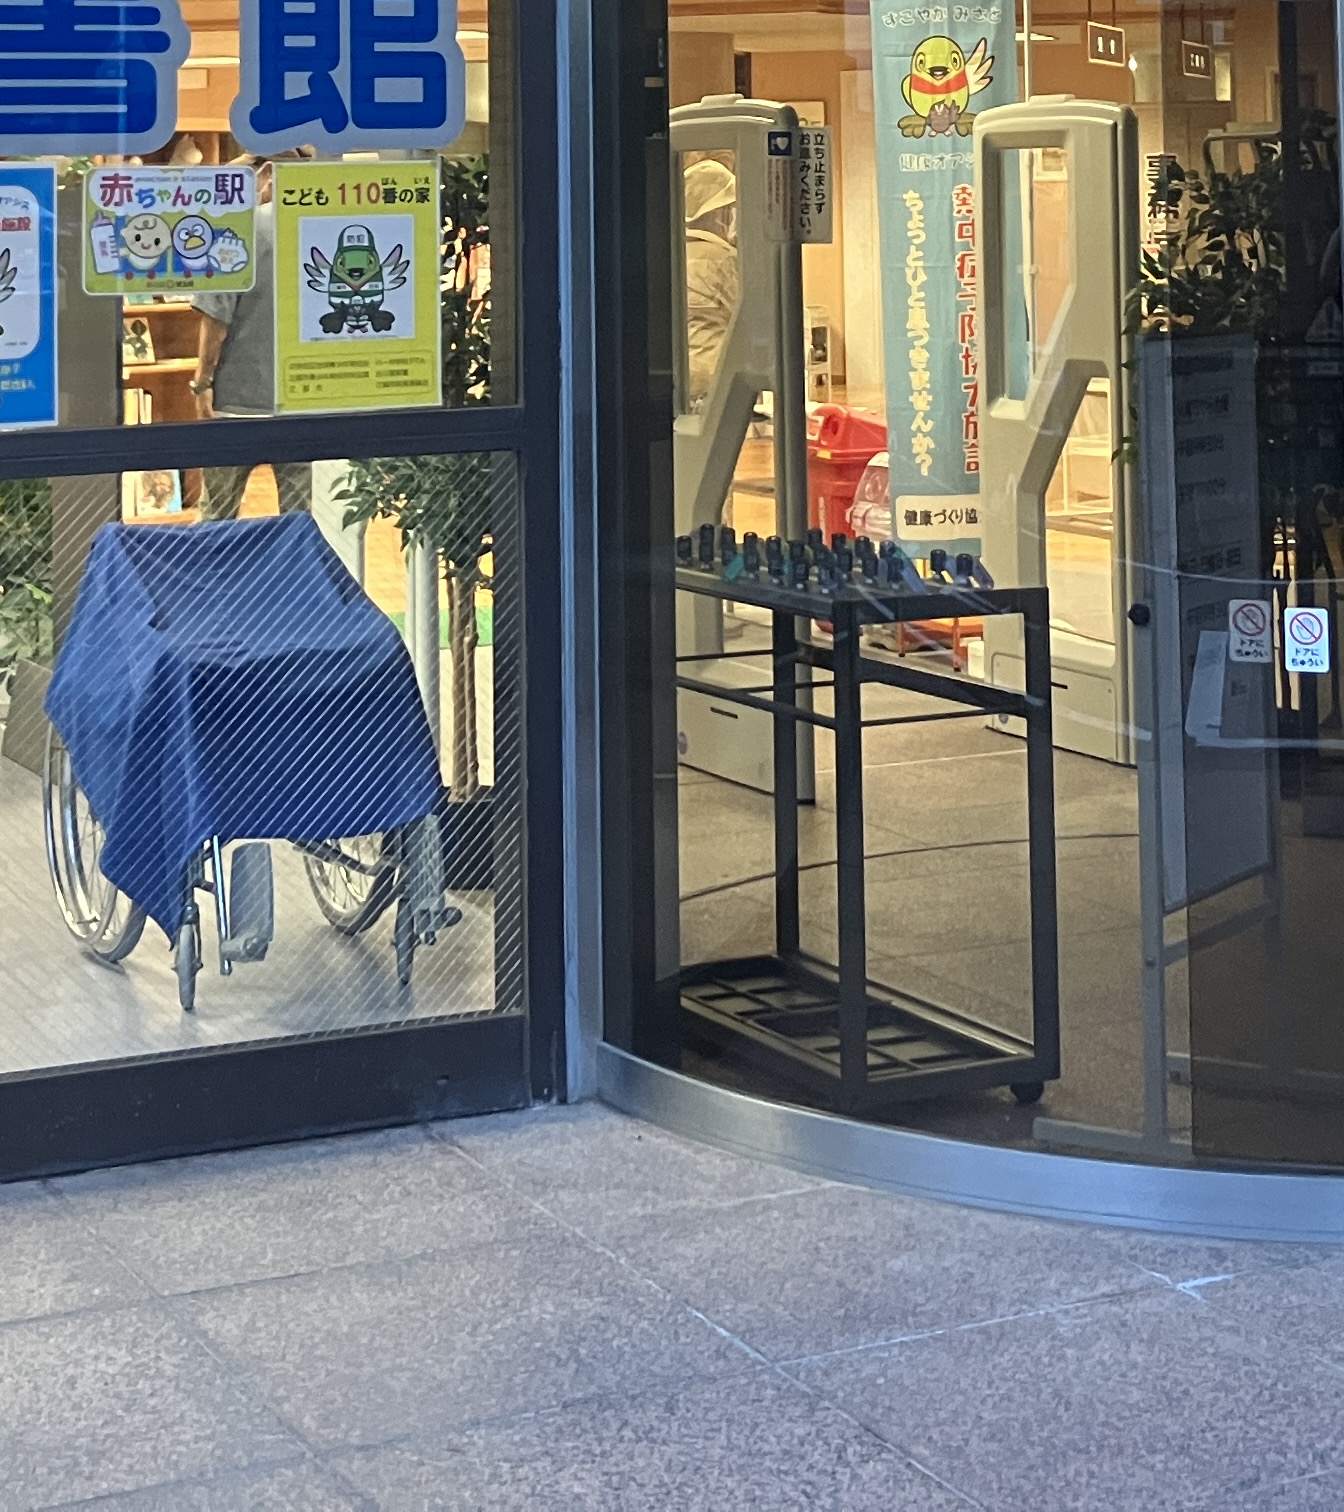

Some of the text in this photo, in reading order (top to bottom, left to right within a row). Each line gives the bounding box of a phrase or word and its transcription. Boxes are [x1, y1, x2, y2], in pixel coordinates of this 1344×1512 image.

[99, 172, 245, 209] 赤ちゃんの駅
[1295, 647, 1320, 657] ドアに
